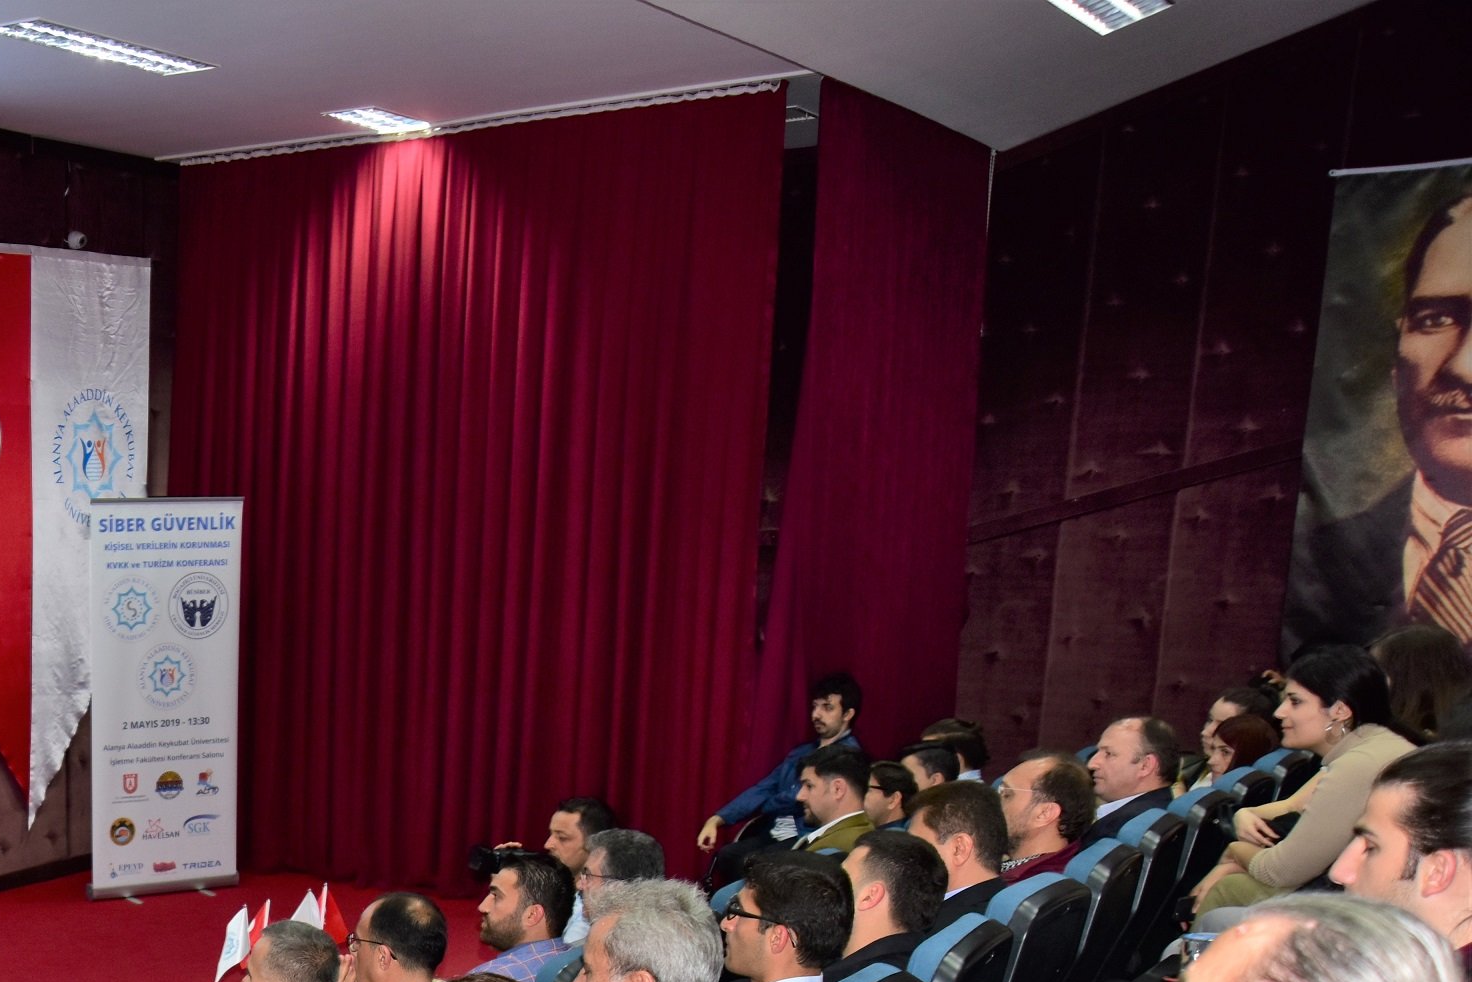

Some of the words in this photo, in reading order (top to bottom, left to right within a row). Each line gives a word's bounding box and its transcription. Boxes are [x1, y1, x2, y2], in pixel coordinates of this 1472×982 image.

[98, 514, 146, 533] SİBER
[151, 512, 236, 531] GÜVENLİK
[180, 540, 230, 549] KORUNMASI
[176, 558, 228, 567] KONFERANSI
[122, 721, 128, 730] 2
[131, 719, 159, 729] MAYIS
[160, 718, 180, 728] 2019
[189, 717, 210, 726] 13:30
[188, 821, 211, 834] SGK
